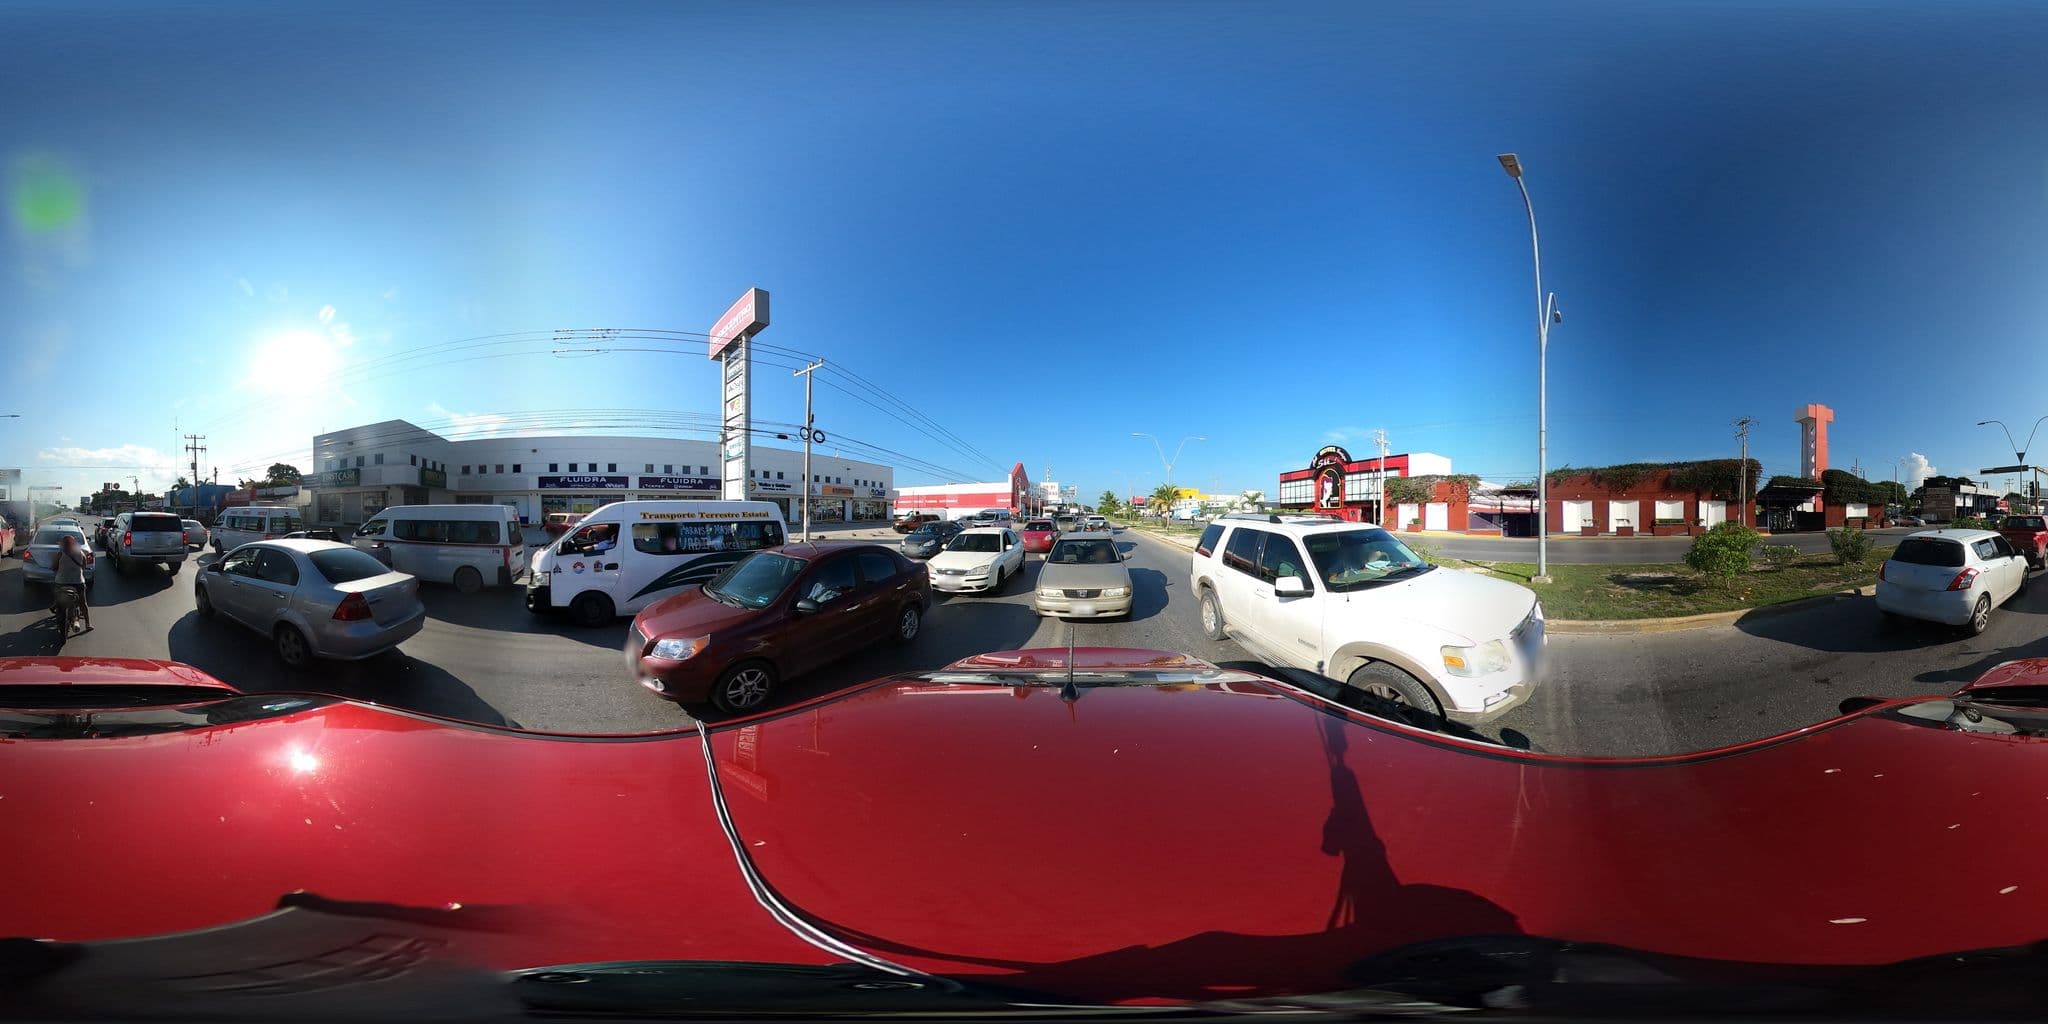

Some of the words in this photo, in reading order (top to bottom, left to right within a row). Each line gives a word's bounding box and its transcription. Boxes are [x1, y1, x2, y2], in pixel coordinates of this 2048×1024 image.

[640, 511, 696, 521] Transporte
[698, 511, 740, 520] Terrestre
[741, 511, 769, 519] Estatal
